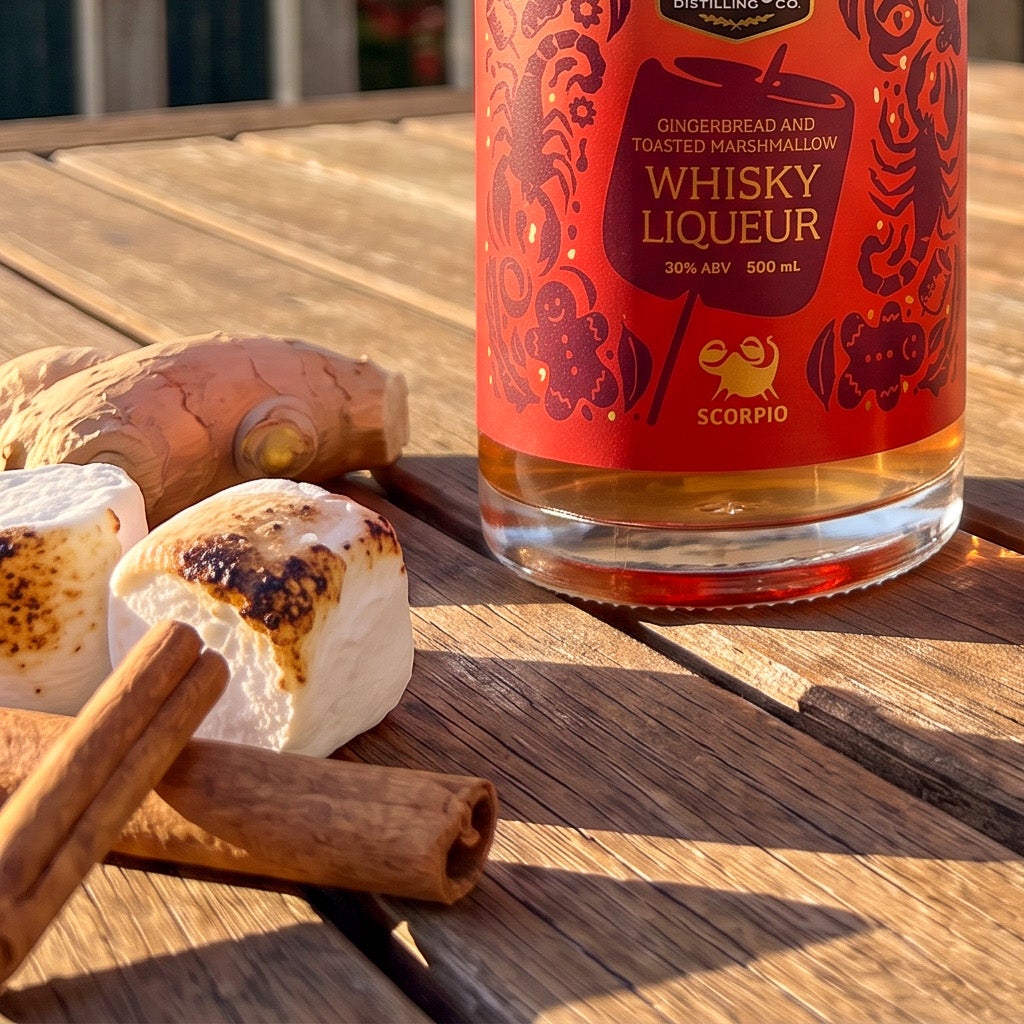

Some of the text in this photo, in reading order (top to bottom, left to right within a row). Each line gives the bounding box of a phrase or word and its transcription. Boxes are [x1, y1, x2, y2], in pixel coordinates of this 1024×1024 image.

[657, 117, 815, 133] GINGERBREAD AND
[632, 136, 838, 153] TOASTED MARSHMALLOW
[645, 164, 821, 200] WHISKY
[642, 208, 821, 250] LIQUEUR
[665, 260, 801, 274] 30% ABV 500 mL
[697, 405, 788, 426] SCORPIO
